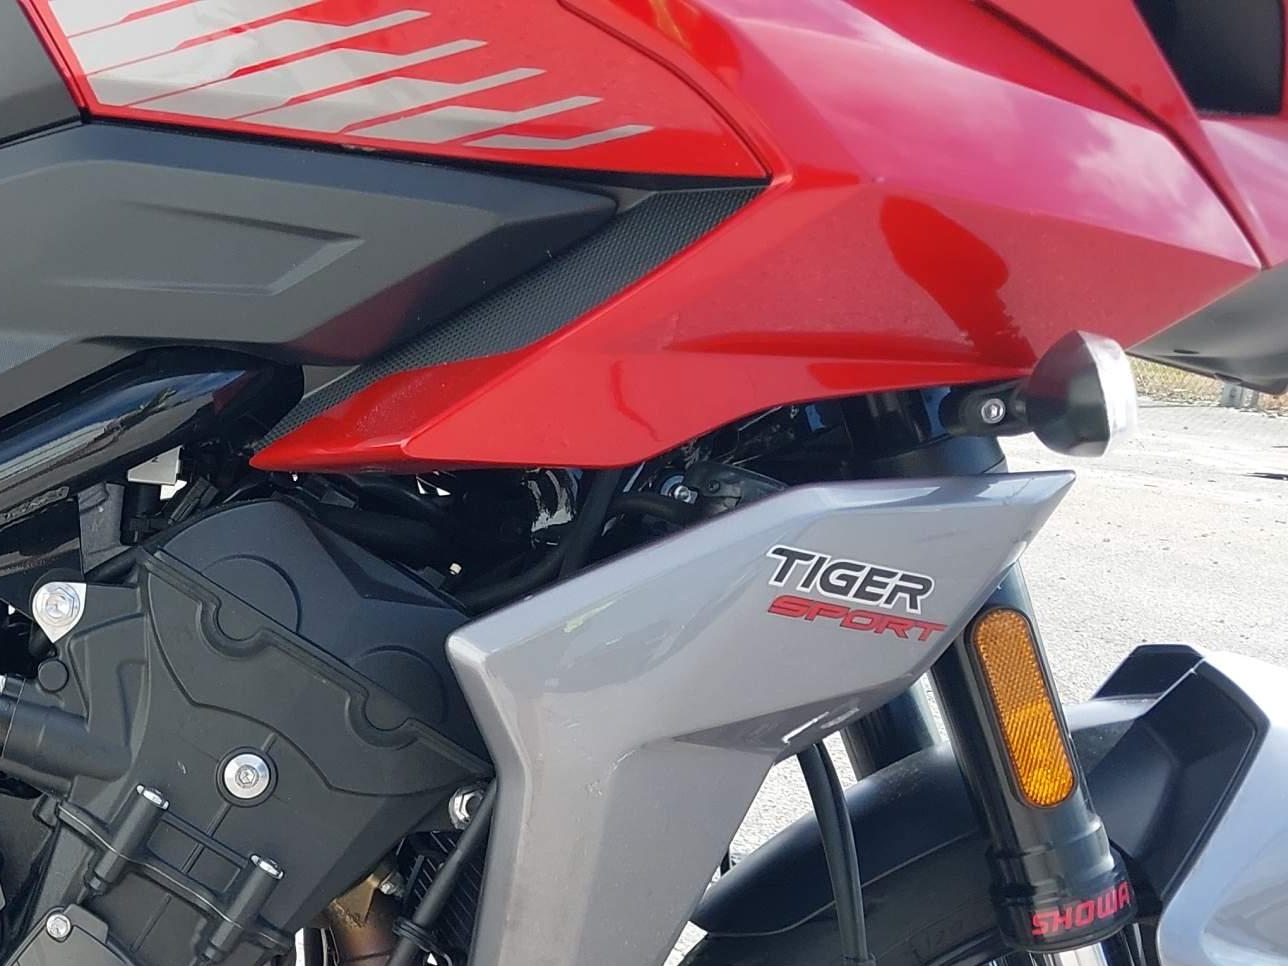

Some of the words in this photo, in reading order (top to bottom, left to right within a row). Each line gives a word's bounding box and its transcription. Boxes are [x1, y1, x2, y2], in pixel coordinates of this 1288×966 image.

[767, 545, 934, 614] TIGER
[768, 594, 948, 641] SPORT
[1032, 880, 1131, 936] SHOWA
